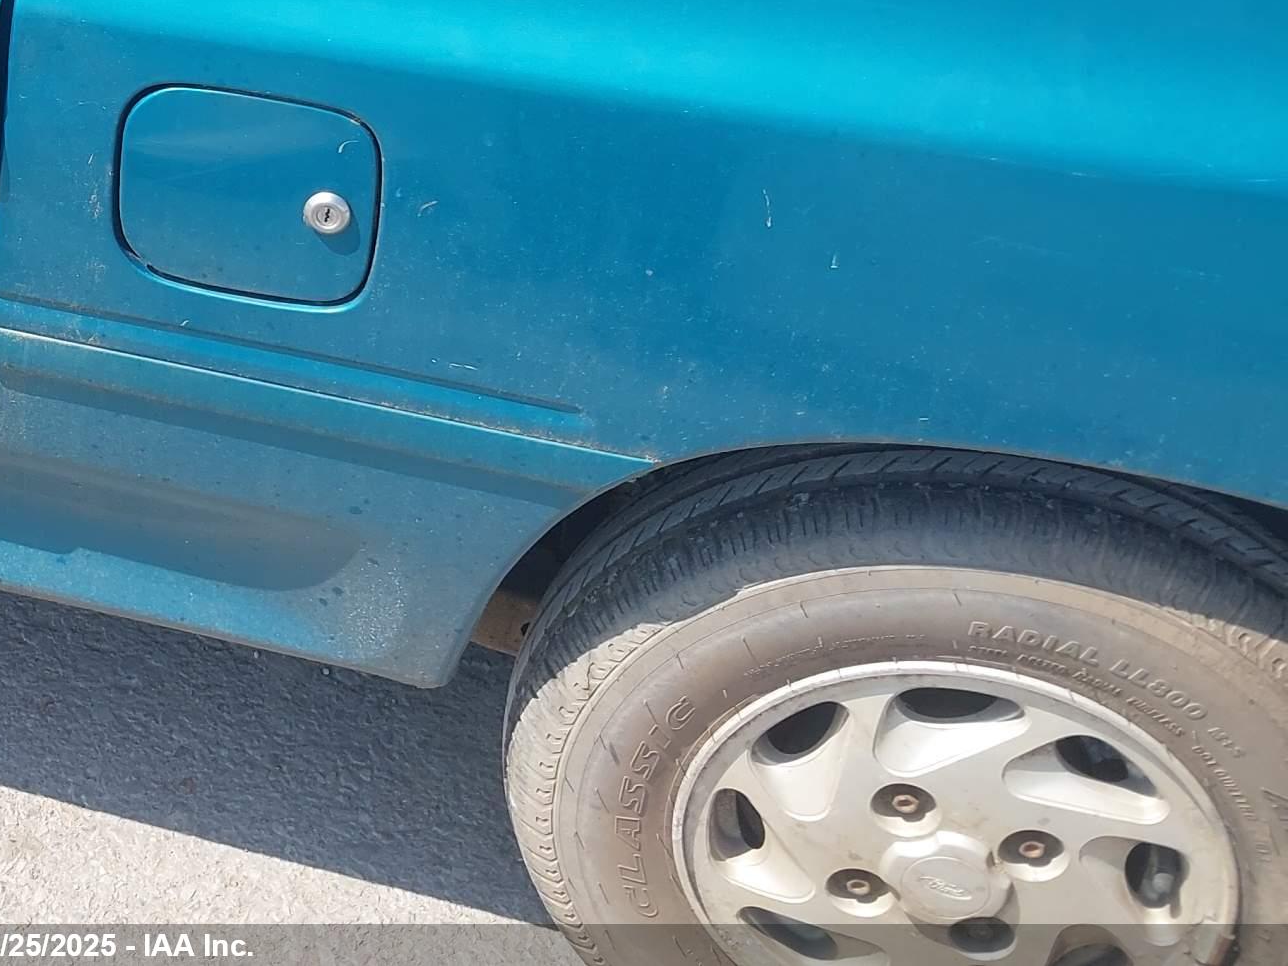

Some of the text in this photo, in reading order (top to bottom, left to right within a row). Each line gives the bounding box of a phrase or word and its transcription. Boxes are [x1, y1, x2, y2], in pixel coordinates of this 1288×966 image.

[968, 620, 1099, 666] RADIAL
[1109, 659, 1208, 721] LL800
[615, 695, 696, 917] CLASSIC
